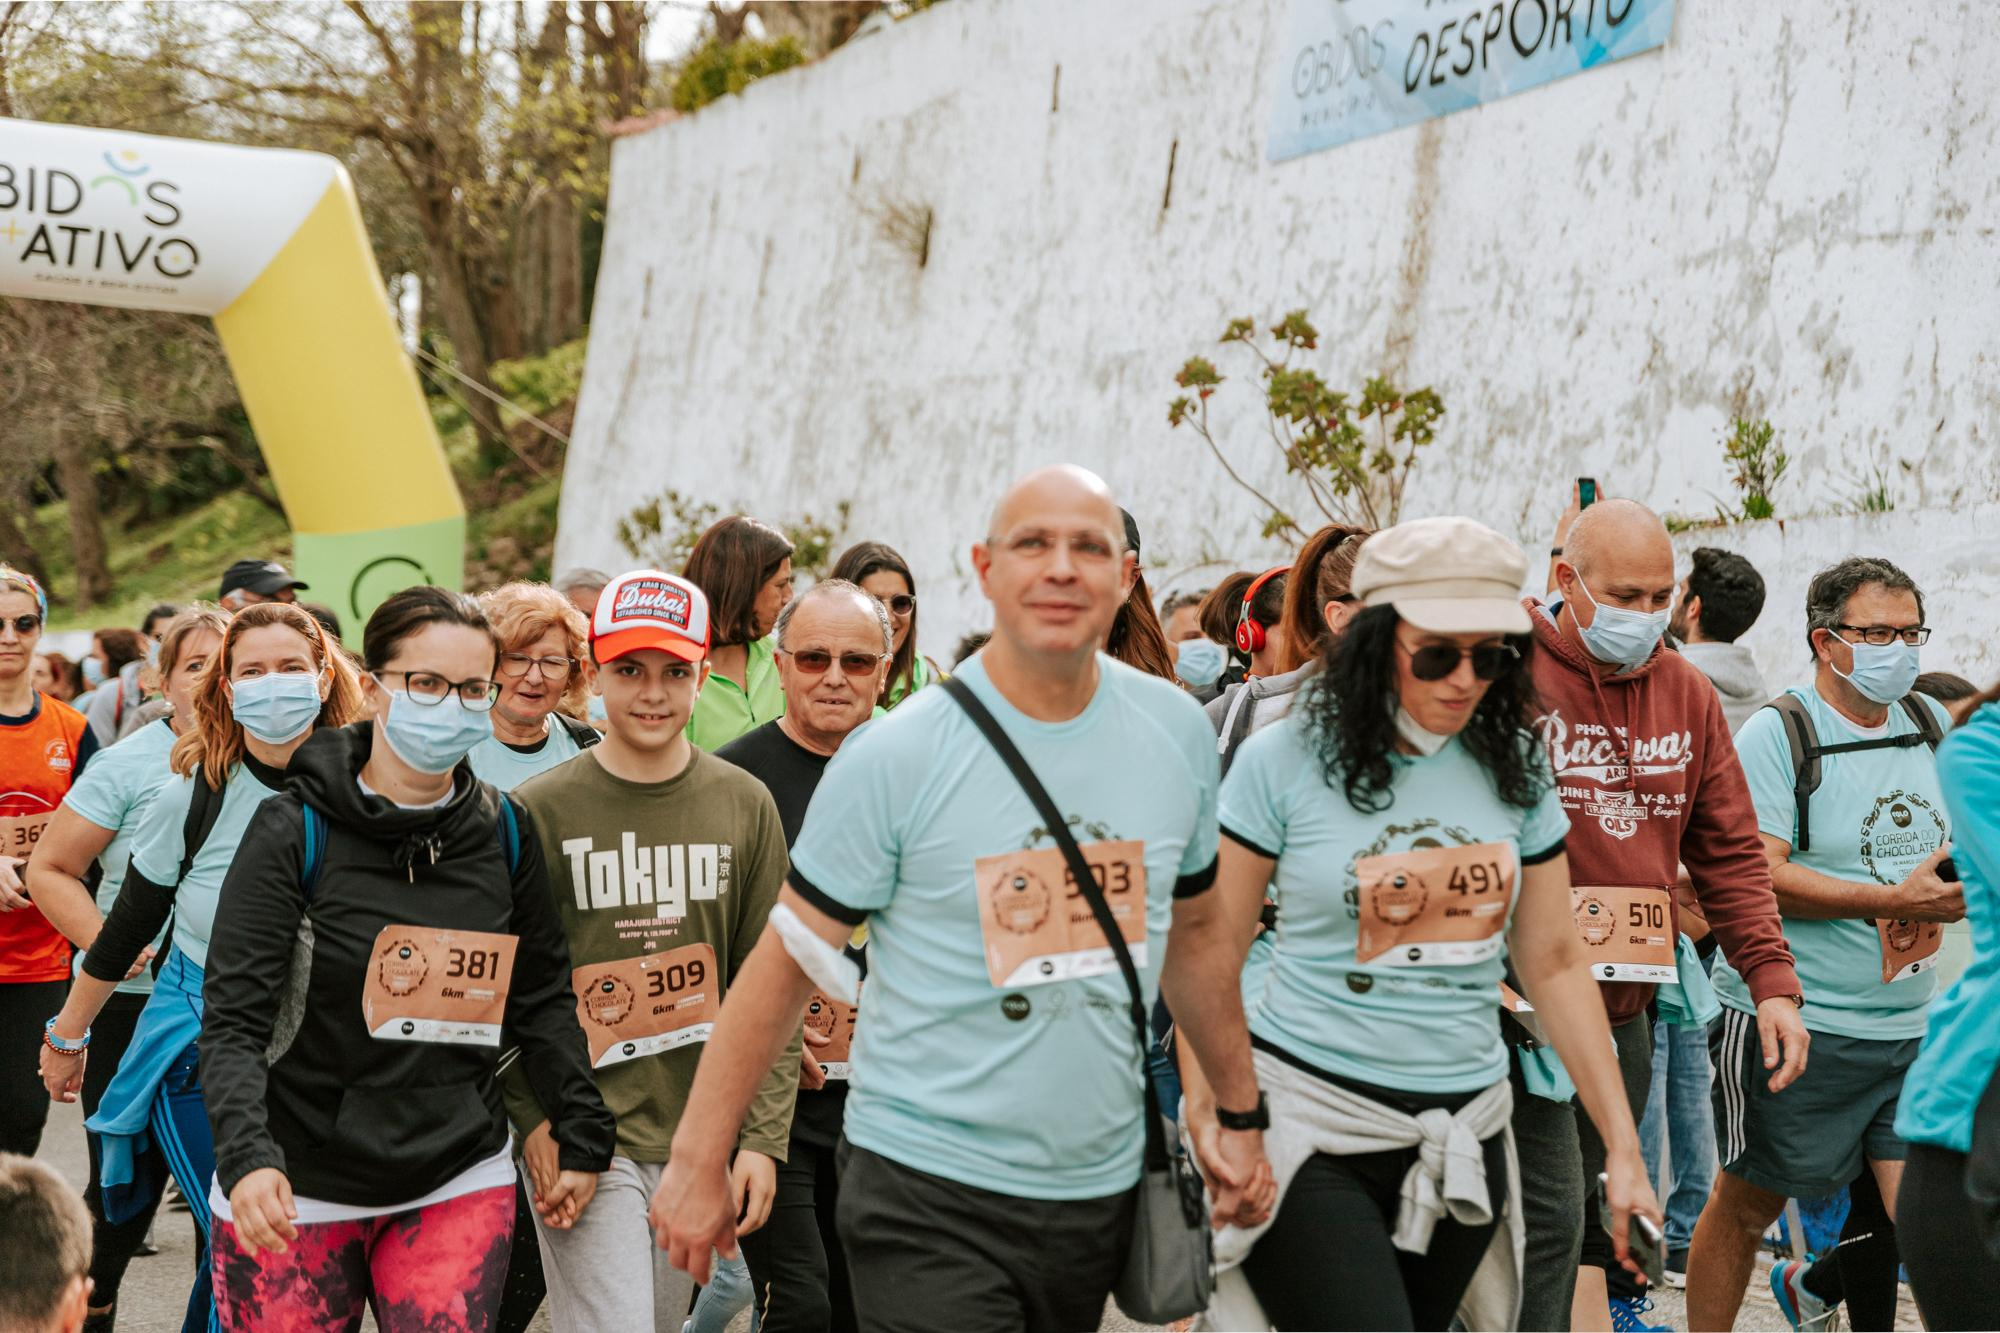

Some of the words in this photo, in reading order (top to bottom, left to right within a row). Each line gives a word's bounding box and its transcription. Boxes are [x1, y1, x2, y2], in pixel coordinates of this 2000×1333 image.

[615, 586, 688, 614] Dubai
[1605, 767, 1646, 781] ARIZNA
[1604, 818, 1633, 833] OILS
[1876, 831, 1919, 847] CORRIDA
[1921, 829, 1936, 840] DO
[1876, 842, 1937, 859] CHOCOLATE
[562, 831, 718, 918] Tokyo
[718, 843, 732, 895] 東京都
[1448, 861, 1504, 896] 491
[614, 918, 651, 928] HARAJUKU
[651, 916, 681, 926] DISTRICT
[1629, 902, 1664, 929] 510
[643, 940, 657, 950] JPN
[1629, 935, 1647, 945] 6km
[446, 948, 500, 981] 381
[646, 959, 705, 998] 309
[441, 987, 465, 999] 6km
[652, 1002, 675, 1015] 6km
